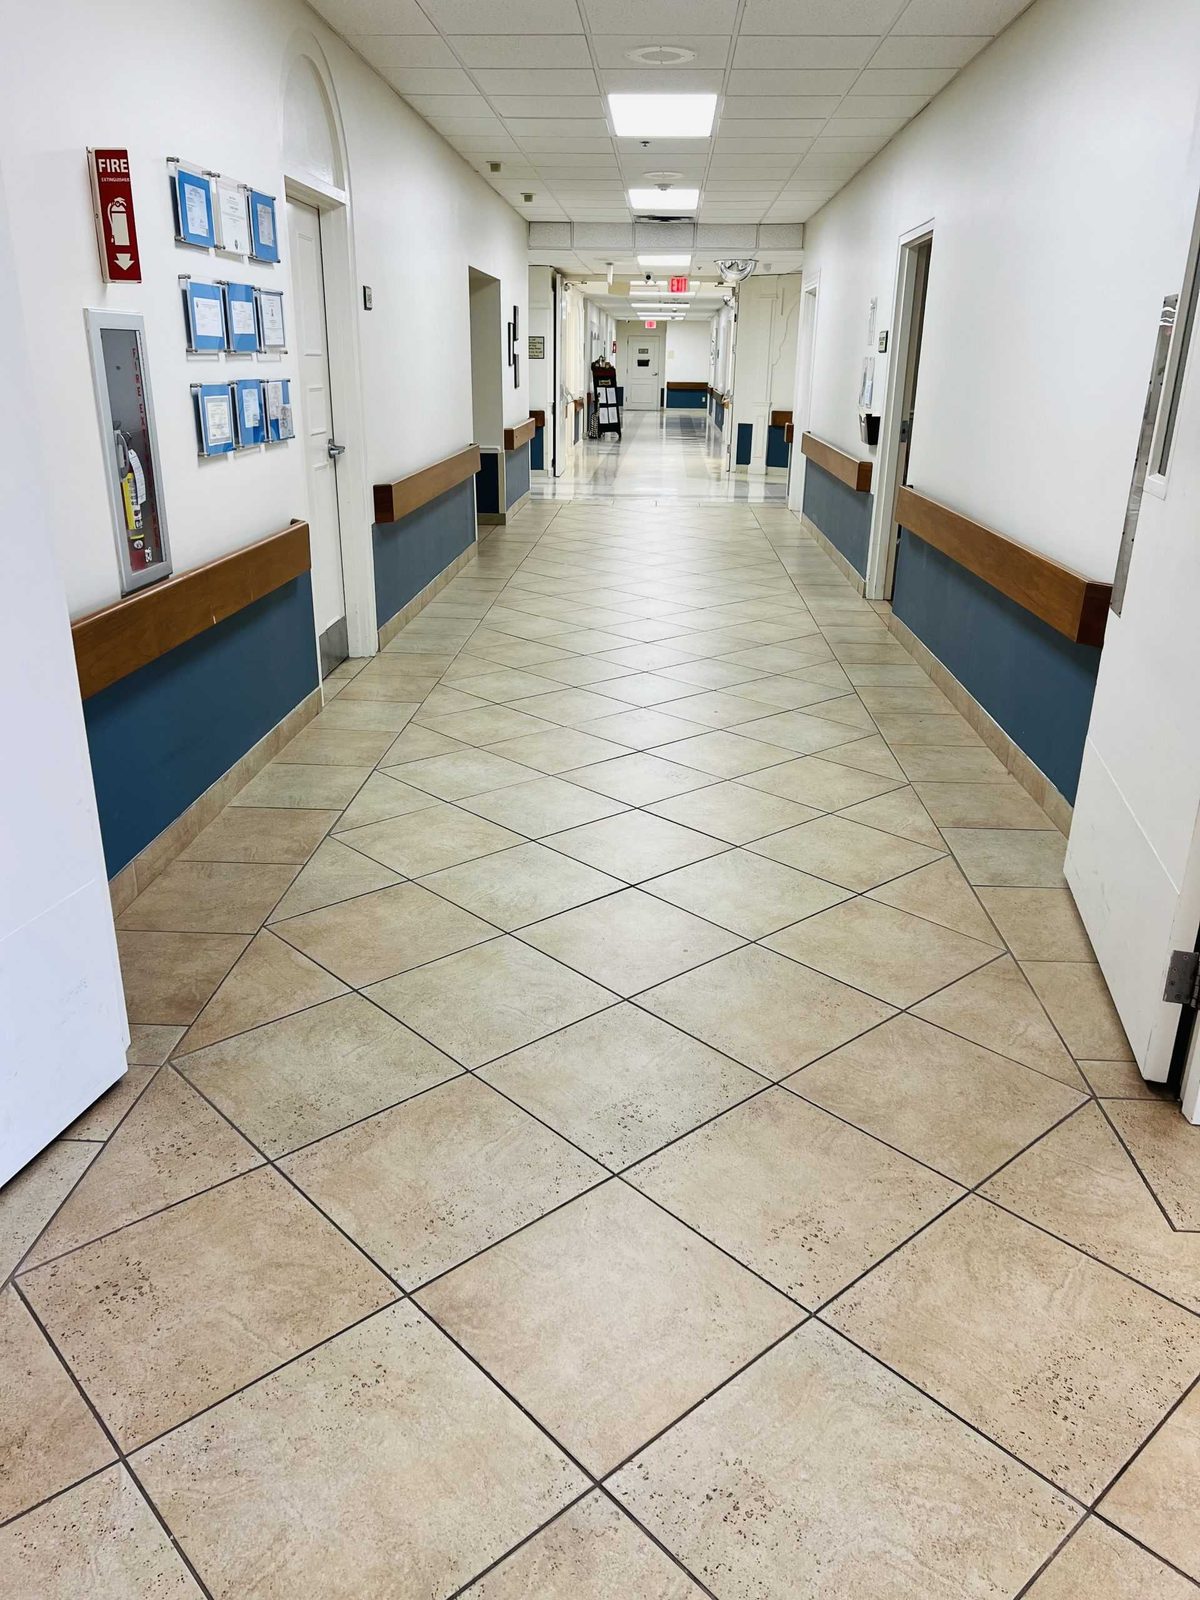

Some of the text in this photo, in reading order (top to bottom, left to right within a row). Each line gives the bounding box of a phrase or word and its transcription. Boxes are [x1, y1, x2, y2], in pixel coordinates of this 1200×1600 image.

[97, 158, 129, 173] FIRE
[671, 278, 688, 292] EXIT
[132, 347, 142, 397] FIRE
